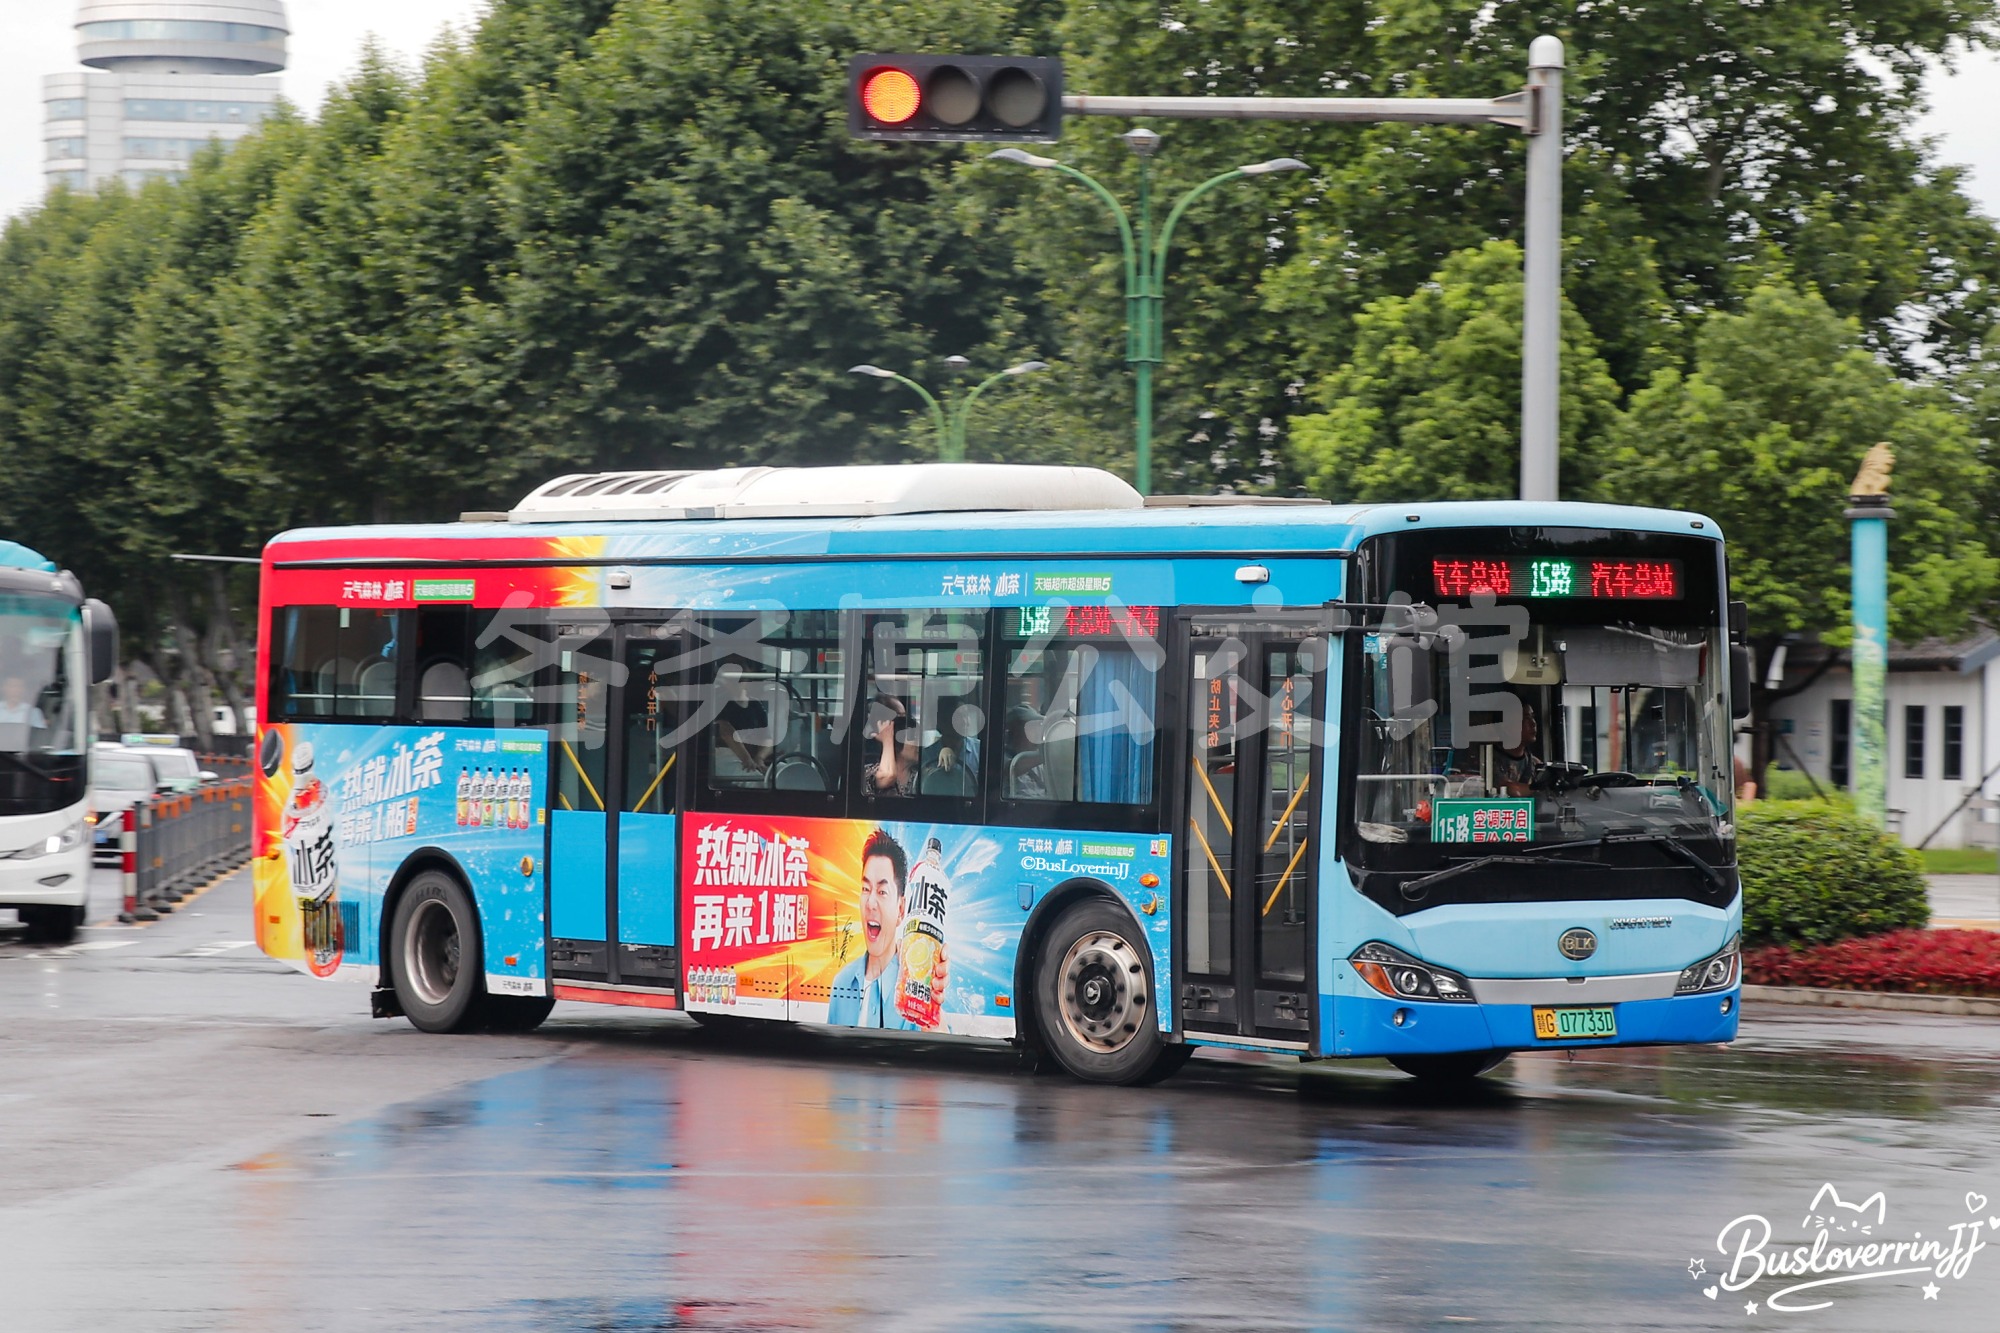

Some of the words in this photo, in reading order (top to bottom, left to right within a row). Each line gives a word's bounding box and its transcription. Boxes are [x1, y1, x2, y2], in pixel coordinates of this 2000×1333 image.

[941, 574, 991, 596] 元气森林
[1530, 561, 1572, 597] 15路
[1591, 562, 1674, 597] 汽车总站
[1019, 605, 1051, 636] 15路
[341, 731, 446, 815] 热就冰茶
[1440, 814, 1470, 843] 15路
[1473, 809, 1528, 829] 空调开启
[693, 820, 810, 887] 热就冰茶
[691, 890, 797, 952] 再来1瓶
